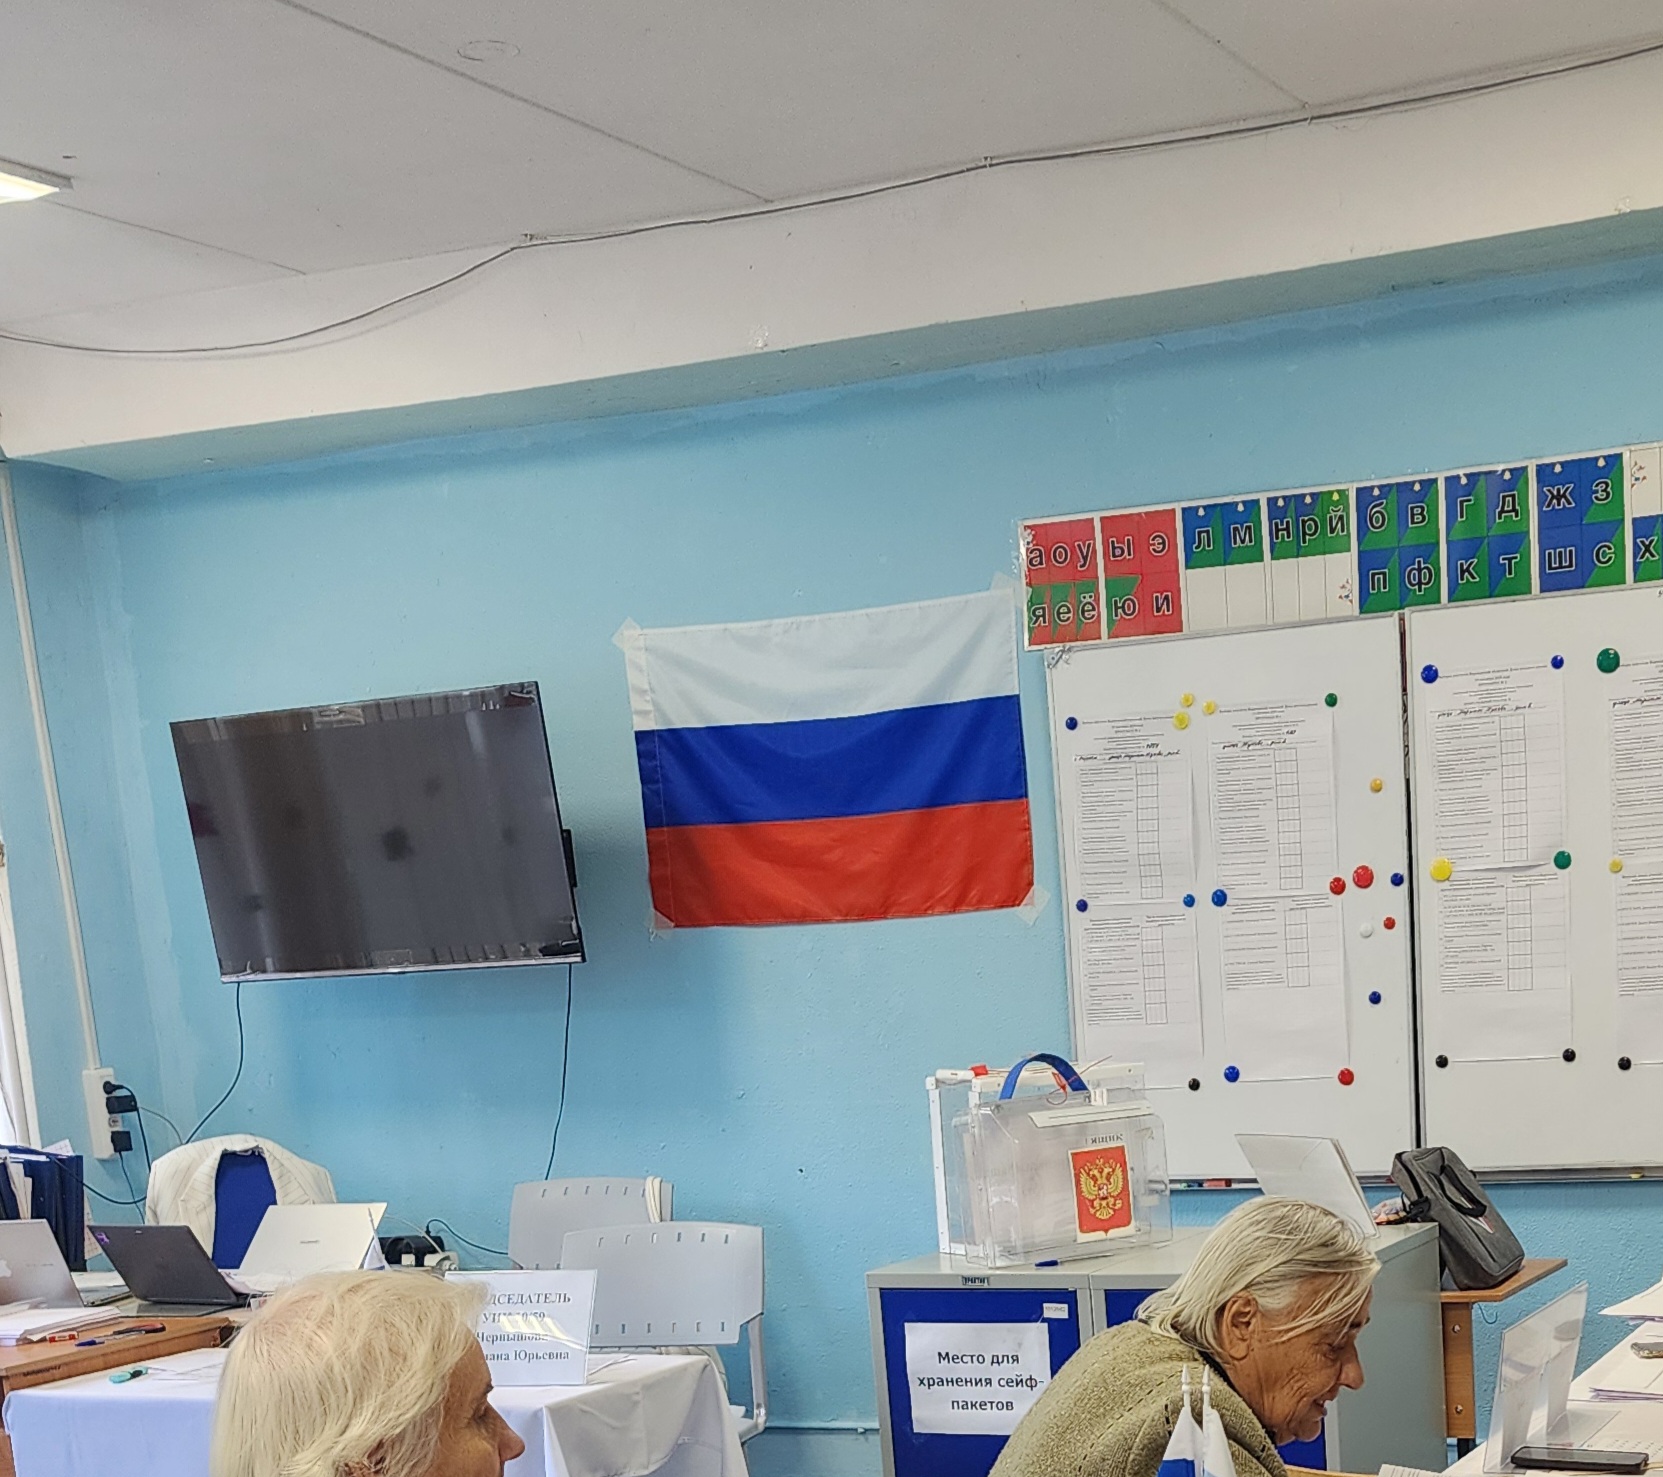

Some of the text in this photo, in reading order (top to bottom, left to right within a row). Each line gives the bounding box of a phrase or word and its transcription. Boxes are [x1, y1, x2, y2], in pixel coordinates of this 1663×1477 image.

[1109, 537, 1132, 560] ы
[1150, 532, 1167, 555] э
[1193, 527, 1213, 551] л
[1368, 500, 1387, 531] б
[1409, 503, 1427, 526] в
[1457, 496, 1474, 521] г
[1496, 492, 1520, 521] д
[1543, 484, 1574, 510] ж
[1592, 479, 1612, 503] з
[1113, 596, 1137, 619] ю
[1154, 592, 1172, 615] и
[1369, 569, 1388, 593] п
[1406, 557, 1433, 594] ф
[1458, 559, 1479, 583] к
[1500, 555, 1520, 578] т
[1546, 548, 1575, 573] ш
[1594, 543, 1614, 567] с
[1636, 537, 1658, 561] х
[490, 1293, 571, 1305] ДСЕДАТЕЛЬ
[514, 1350, 569, 1363] Юрьевна
[938, 1352, 1020, 1369] Место для
[918, 1374, 1044, 1390] хранения сейф-
[952, 1400, 1014, 1411] пакетов
